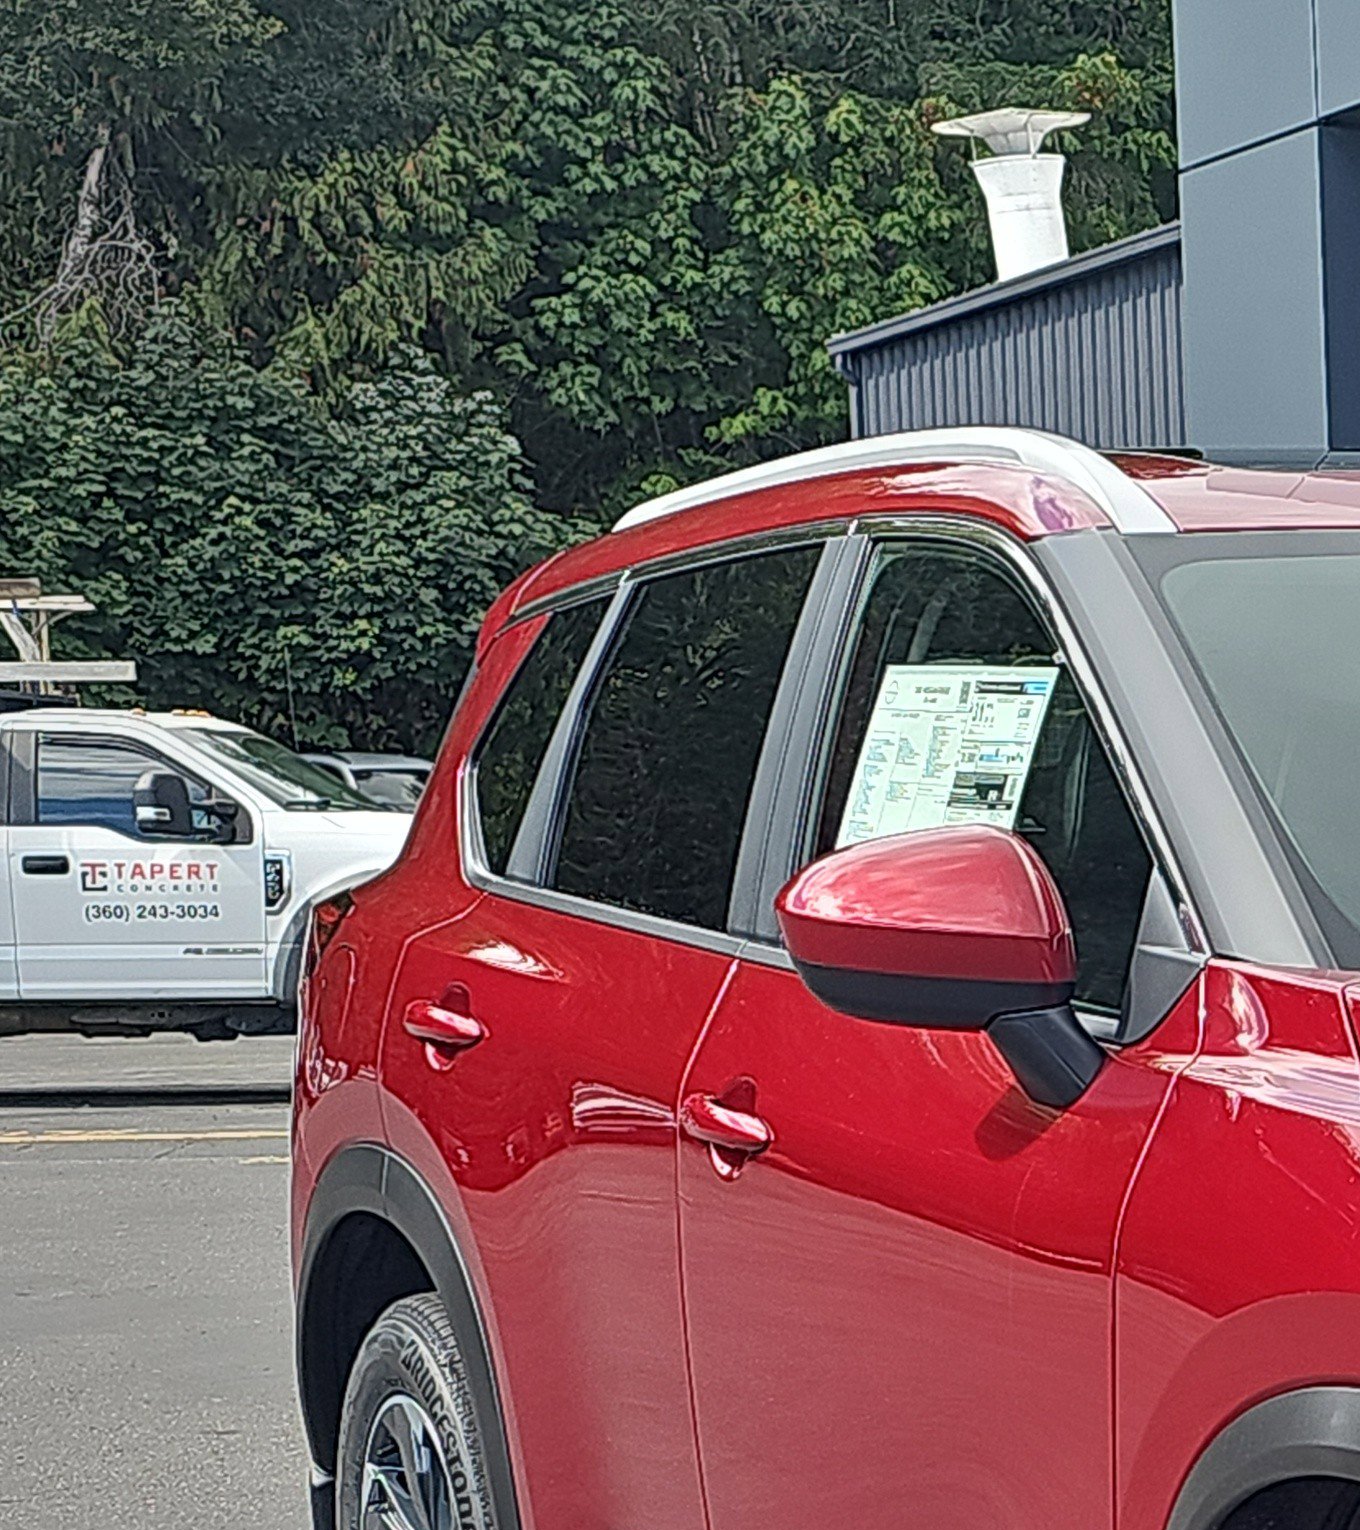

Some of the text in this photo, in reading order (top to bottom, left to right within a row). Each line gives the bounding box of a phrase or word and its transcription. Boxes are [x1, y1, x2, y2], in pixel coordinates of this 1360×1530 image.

[114, 863, 218, 880] TAPERT
[116, 884, 219, 893] CONCRETE
[85, 905, 219, 923] (360) 243-3034
